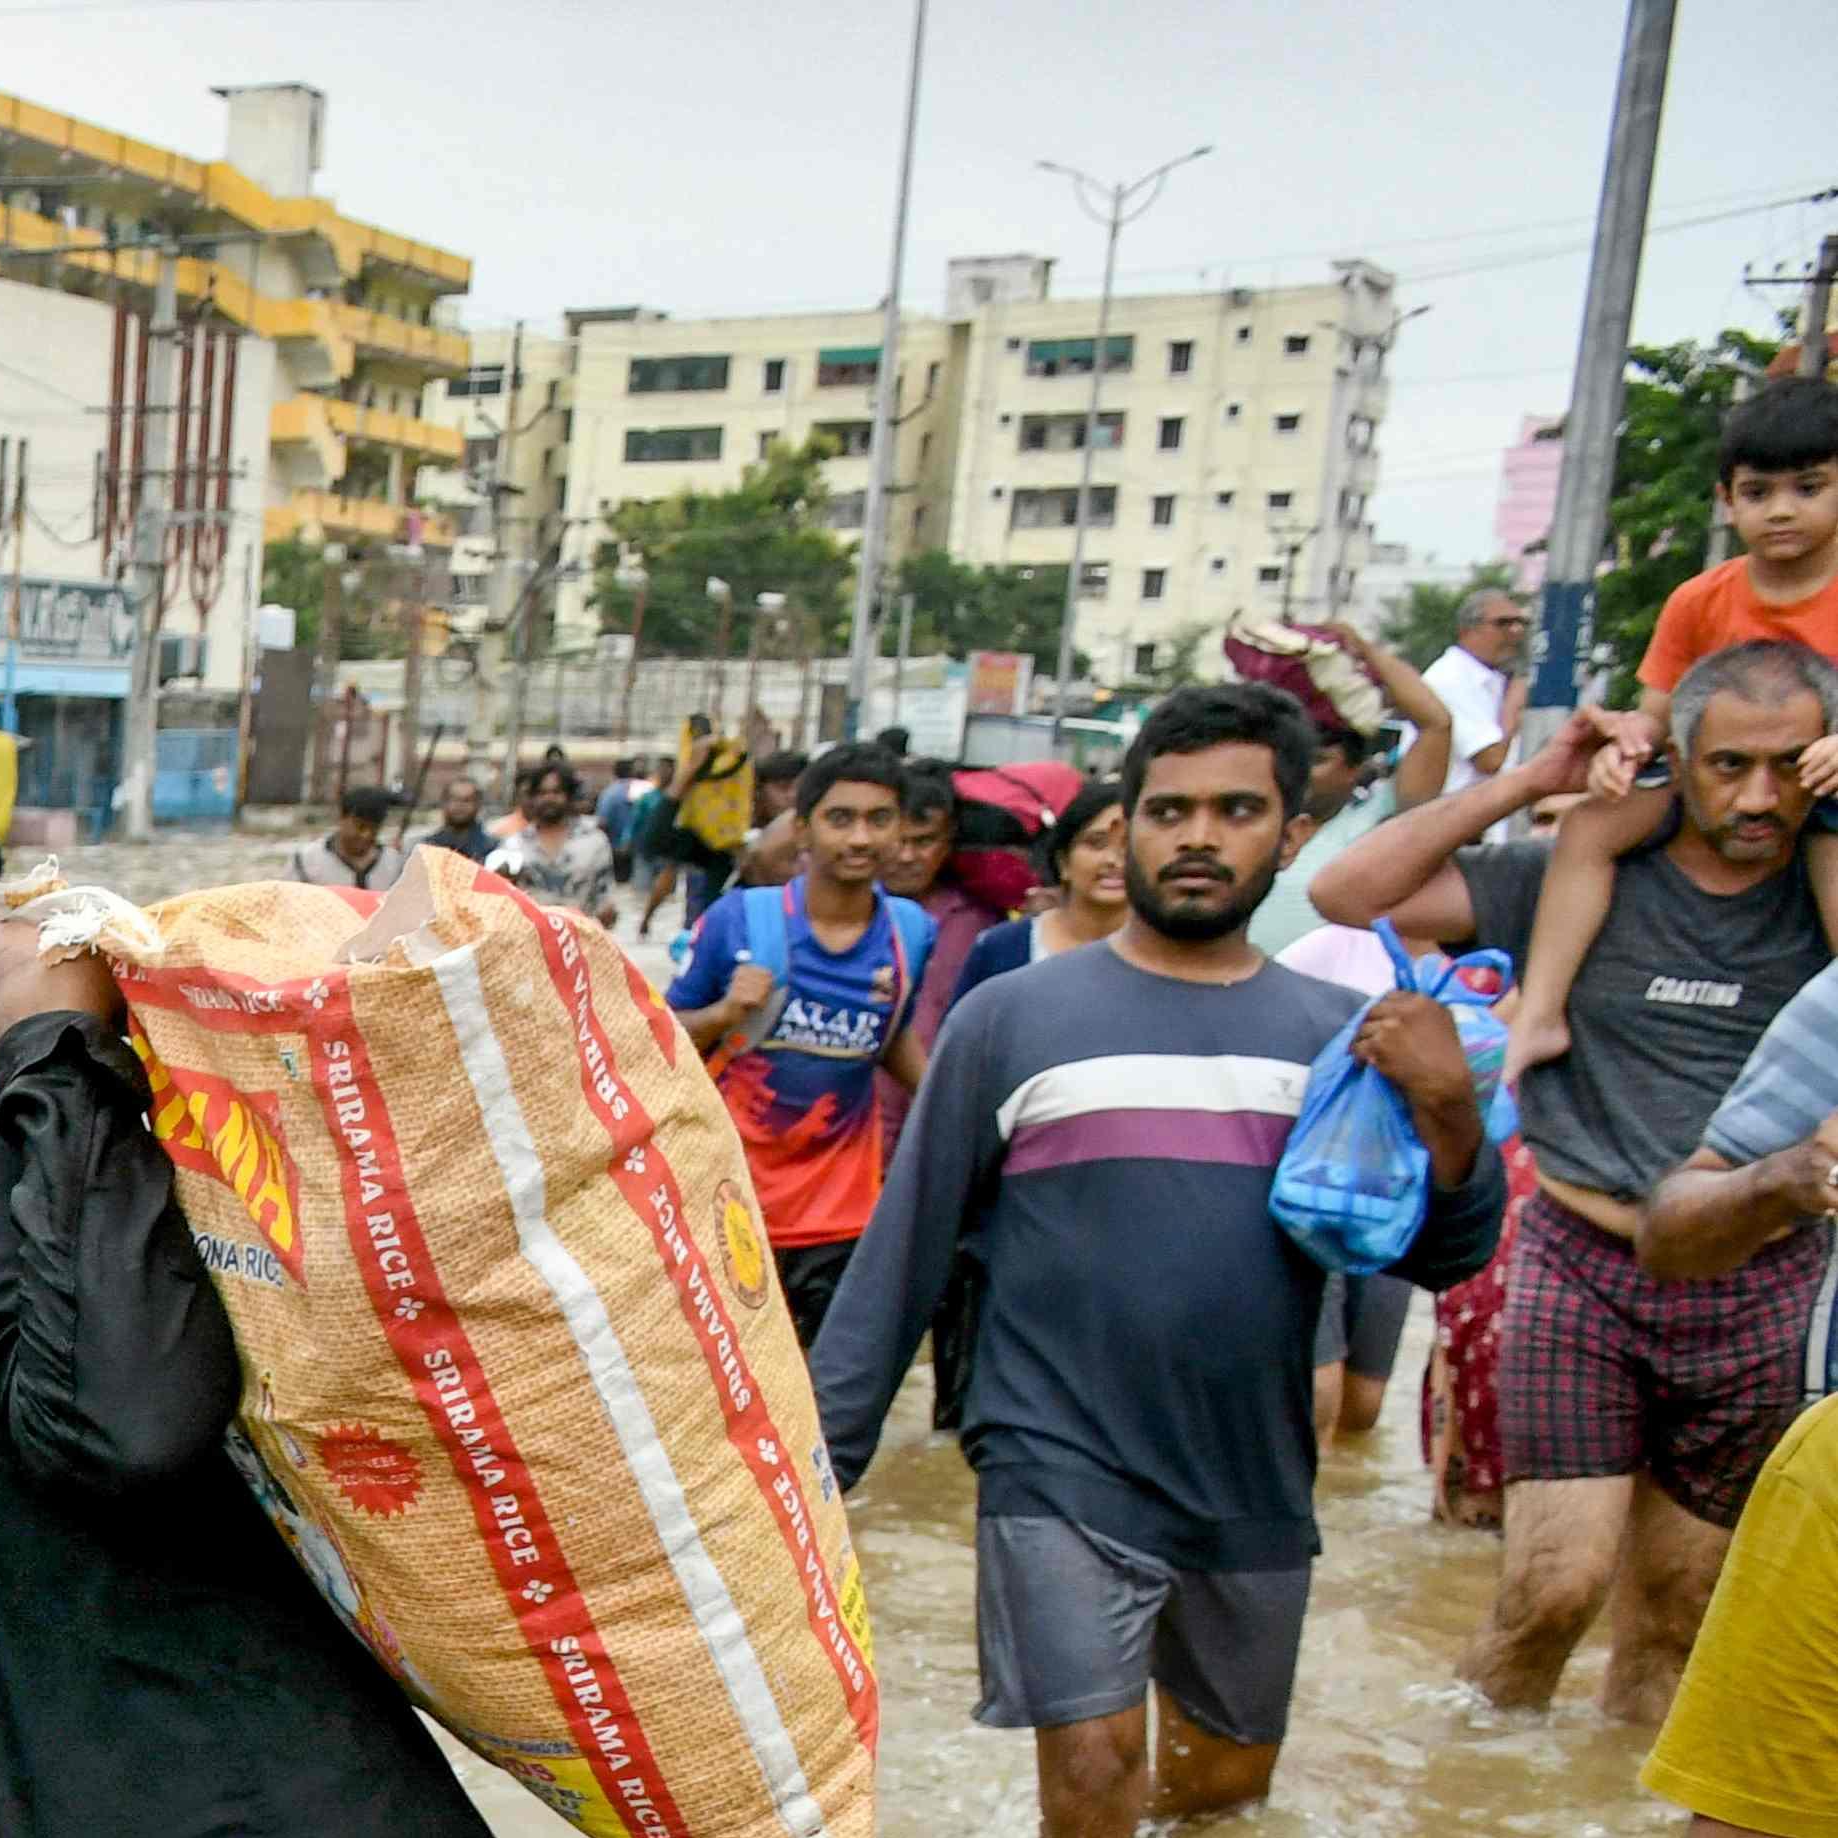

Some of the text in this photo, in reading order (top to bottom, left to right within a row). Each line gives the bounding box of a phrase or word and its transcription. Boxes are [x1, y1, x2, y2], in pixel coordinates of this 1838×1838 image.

[323, 1039, 417, 1291] SRIRAMA RICE
[649, 1183, 689, 1265] RICE
[193, 1233, 240, 1272] ONA
[687, 1263, 752, 1413] SRIRAMA
[424, 1347, 541, 1567] SRIRAMA RICE
[772, 1470, 811, 1550] RICE
[804, 1547, 866, 1693] SRIRAMA
[550, 1635, 632, 1773] SRIRAMA
